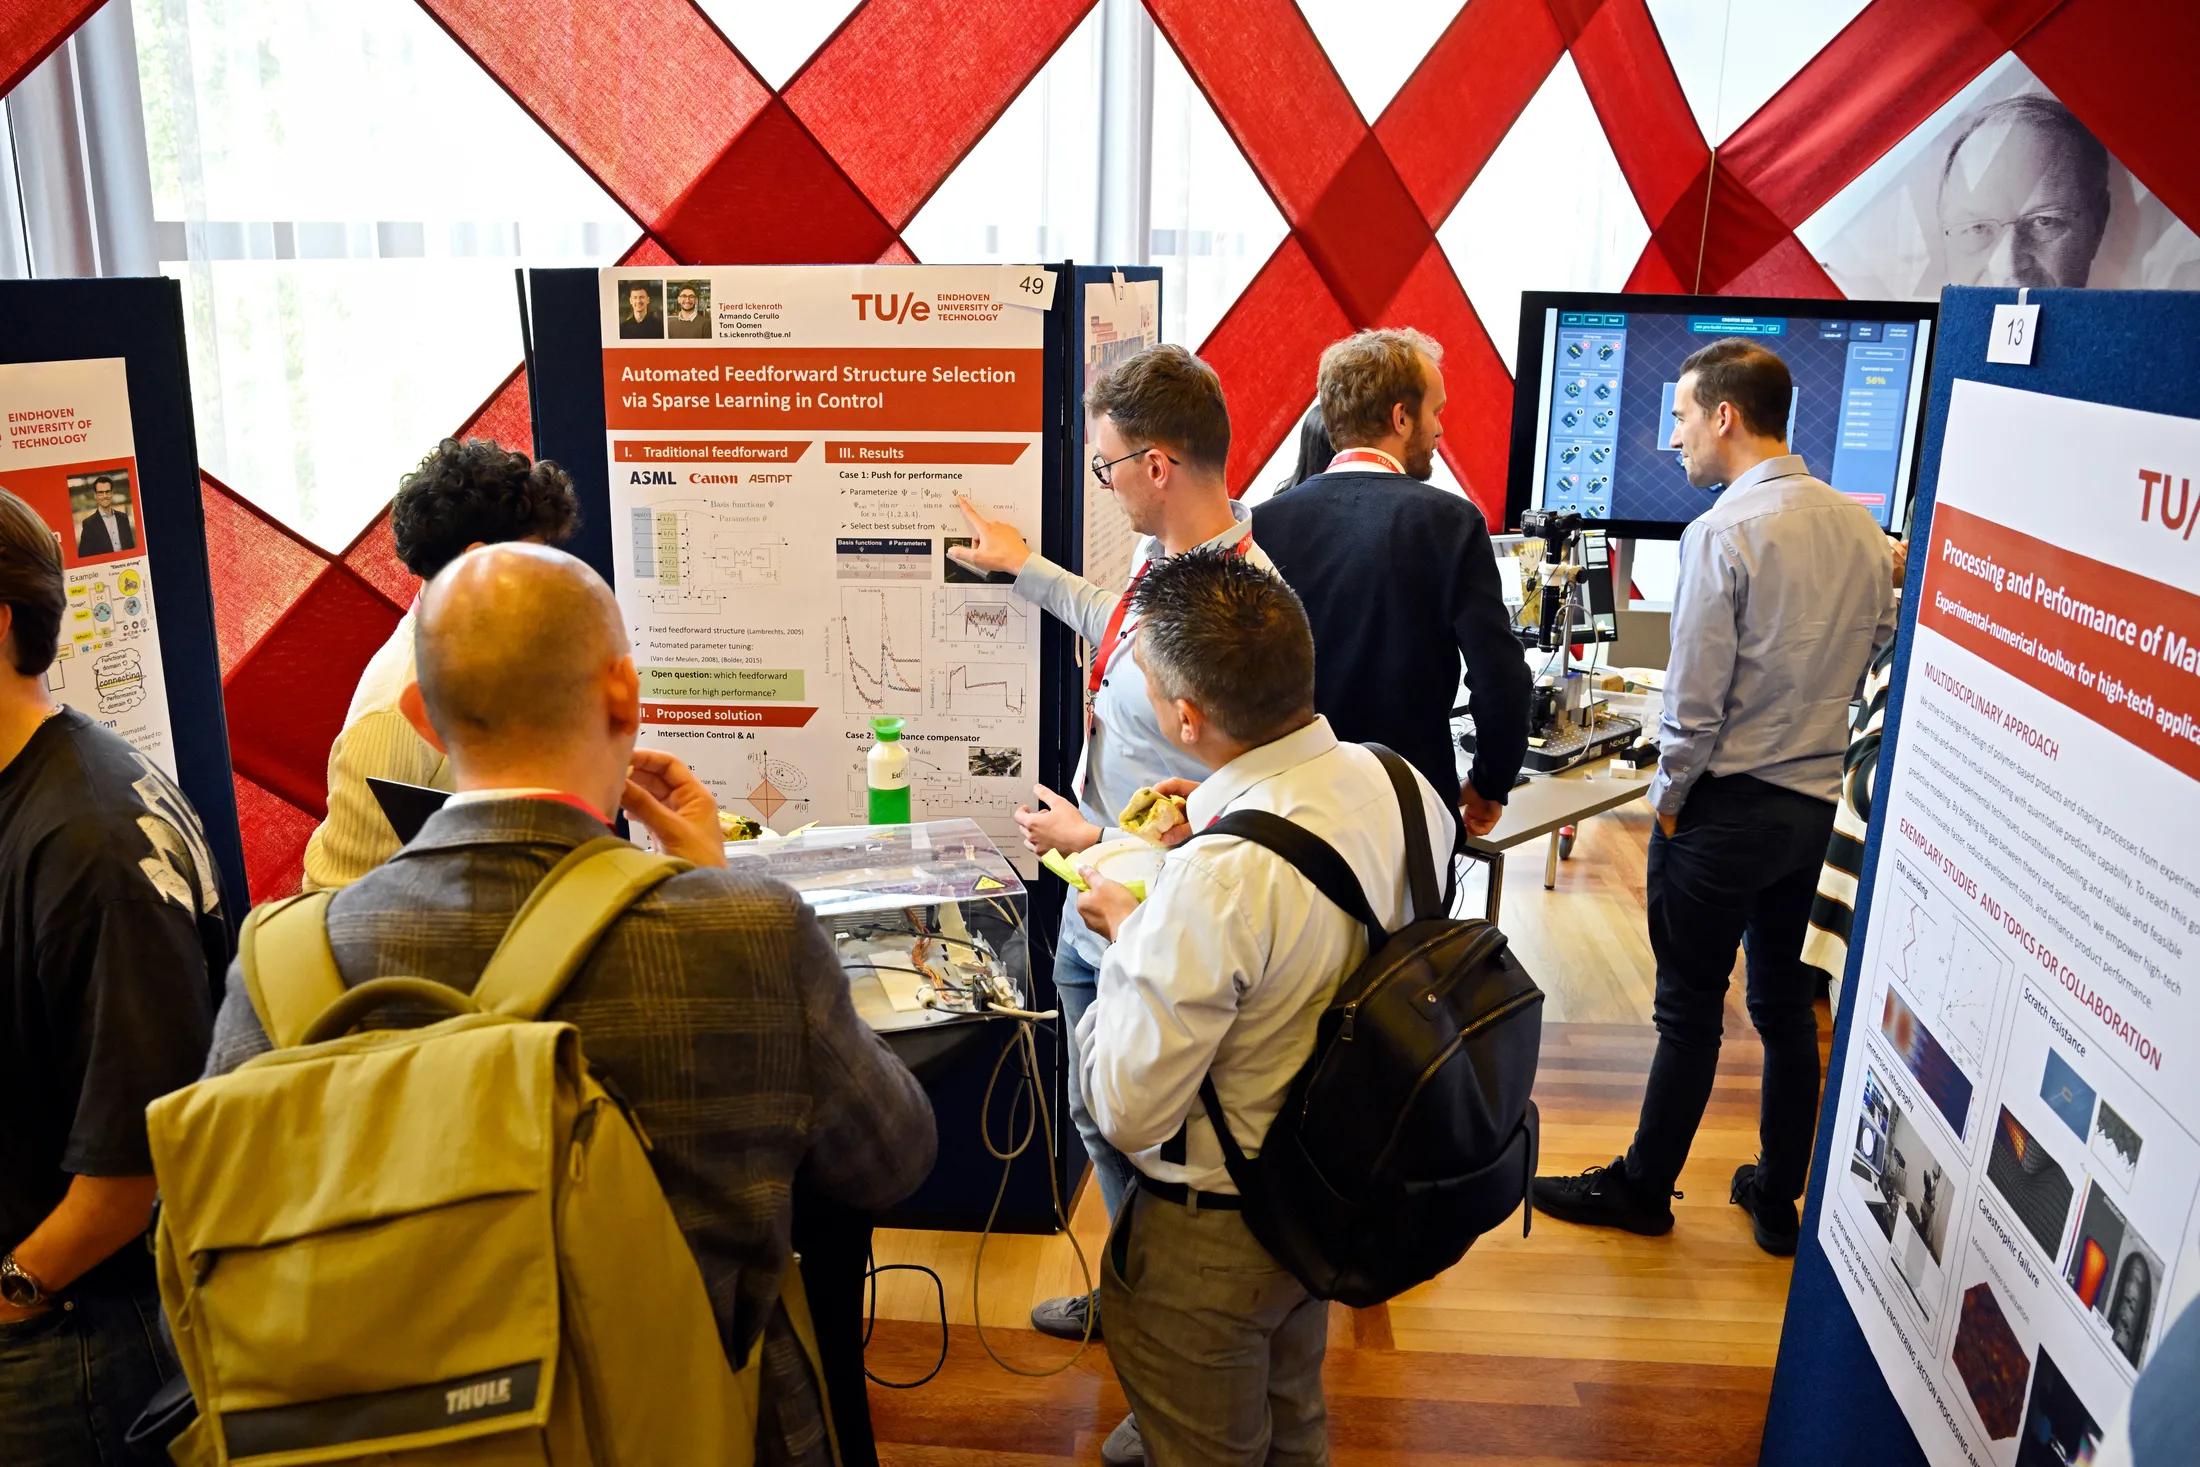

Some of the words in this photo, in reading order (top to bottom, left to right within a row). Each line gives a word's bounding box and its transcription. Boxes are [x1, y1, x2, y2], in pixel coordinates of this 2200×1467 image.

[1019, 276, 1044, 294] 49
[719, 302, 743, 312] Tjeerd
[745, 302, 782, 311] Ickenroth
[852, 292, 930, 324] TU/e
[719, 312, 753, 320] Armando
[755, 312, 779, 320] Cerullo
[738, 321, 762, 329] Oomen
[2007, 318, 2025, 346] 13
[719, 331, 791, 339] t.s.ickenroth@tue.nl
[621, 366, 719, 382] Automated
[725, 366, 837, 382] Feedforward
[843, 367, 926, 383] Structure
[932, 368, 1015, 383] Selection
[622, 394, 647, 408] via
[652, 393, 710, 411] Sparse
[715, 393, 791, 411] Learning
[796, 393, 812, 408] in
[818, 393, 882, 408] Control
[8, 408, 74, 422] EINDHOVEN
[10, 422, 74, 435] UNIVERSITY
[78, 420, 92, 429] OF
[13, 434, 87, 449] TECHNOLOGY
[644, 447, 709, 457] Traditional
[712, 447, 788, 457] feedforward
[839, 447, 855, 458] III.
[859, 448, 904, 458] Results
[630, 471, 677, 485] ASML
[689, 473, 738, 484] Canon
[749, 474, 792, 483] ASMPT
[908, 472, 962, 480] performance
[70, 572, 98, 582] Example
[1943, 539, 2005, 592] Processing
[2007, 572, 2034, 599] and
[2035, 578, 2137, 645] Performance
[2140, 625, 2164, 656] of
[668, 626, 711, 634] feedforward
[747, 628, 785, 636] (Lambrechts,
[728, 643, 753, 651] tuning:
[102, 654, 126, 662] Functional
[1935, 591, 2037, 657] Experimental-numerical
[2038, 643, 2077, 678] toolbox
[2078, 662, 2096, 688] for
[2097, 671, 2155, 719] high-tech
[100, 672, 140, 687] connecting
[652, 671, 672, 679] Open
[674, 671, 712, 679] question:
[739, 672, 787, 680] feedforward
[107, 691, 137, 701] Performance
[653, 688, 687, 696] structure
[702, 688, 719, 697] high
[721, 689, 776, 697] performance?
[108, 701, 125, 709] domain
[1925, 662, 2003, 724] MULTIDISCIPLINARY
[2003, 714, 2059, 761] APPROACH
[657, 709, 711, 721] Proposed
[714, 710, 762, 720] solution
[707, 731, 735, 739] Control
[845, 732, 863, 740] Case
[927, 734, 980, 743] compensator
[1609, 736, 1630, 748] NEXUS
[1994, 749, 2035, 783] polymer-based
[2035, 778, 2062, 802] products
[2063, 797, 2077, 812] and
[2077, 806, 2103, 833] shaping
[2103, 825, 2137, 856] processes
[2139, 847, 2158, 870] from
[2028, 804, 2063, 837] quantitative
[2064, 831, 2096, 861] predictive
[2136, 880, 2144, 896] To
[2146, 891, 2169, 913] reach
[2171, 906, 2187, 926] this
[1896, 860, 1906, 875] EMI
[1906, 871, 1928, 900] shielding
[2021, 831, 2055, 863] constitutive
[2056, 858, 2088, 891] modelling
[2089, 884, 2103, 899] and
[2104, 895, 2131, 921] reliable
[2133, 917, 2148, 934] and
[2150, 926, 2182, 959] feasible
[2023, 861, 2041, 885] theory
[2042, 878, 2054, 894] and
[2094, 920, 2104, 934] we
[2106, 931, 2142, 963] empower
[2144, 956, 2181, 996] high-tech
[1900, 818, 1943, 867] EXEMPLARY
[1943, 858, 1977, 899] STUDIES
[1980, 893, 2000, 921] AND
[2003, 911, 2035, 954] TOPICS
[2037, 944, 2058, 976] FOR
[2060, 966, 2162, 1071] COLLABORATION
[2048, 914, 2074, 942] enhance
[2075, 939, 2102, 967] product
[2024, 988, 2048, 1020] Scratch
[2049, 1016, 2086, 1057] resistance
[1866, 1039, 1888, 1076] Immersion
[1888, 1069, 1914, 1113] lithography
[1979, 1199, 2017, 1257] Catastrophic
[2017, 1252, 2039, 1288] failure
[446, 1378, 512, 1415] THULE
[1916, 1361, 1937, 1399] SECTION
[1936, 1396, 1968, 1453] PROCESSING
